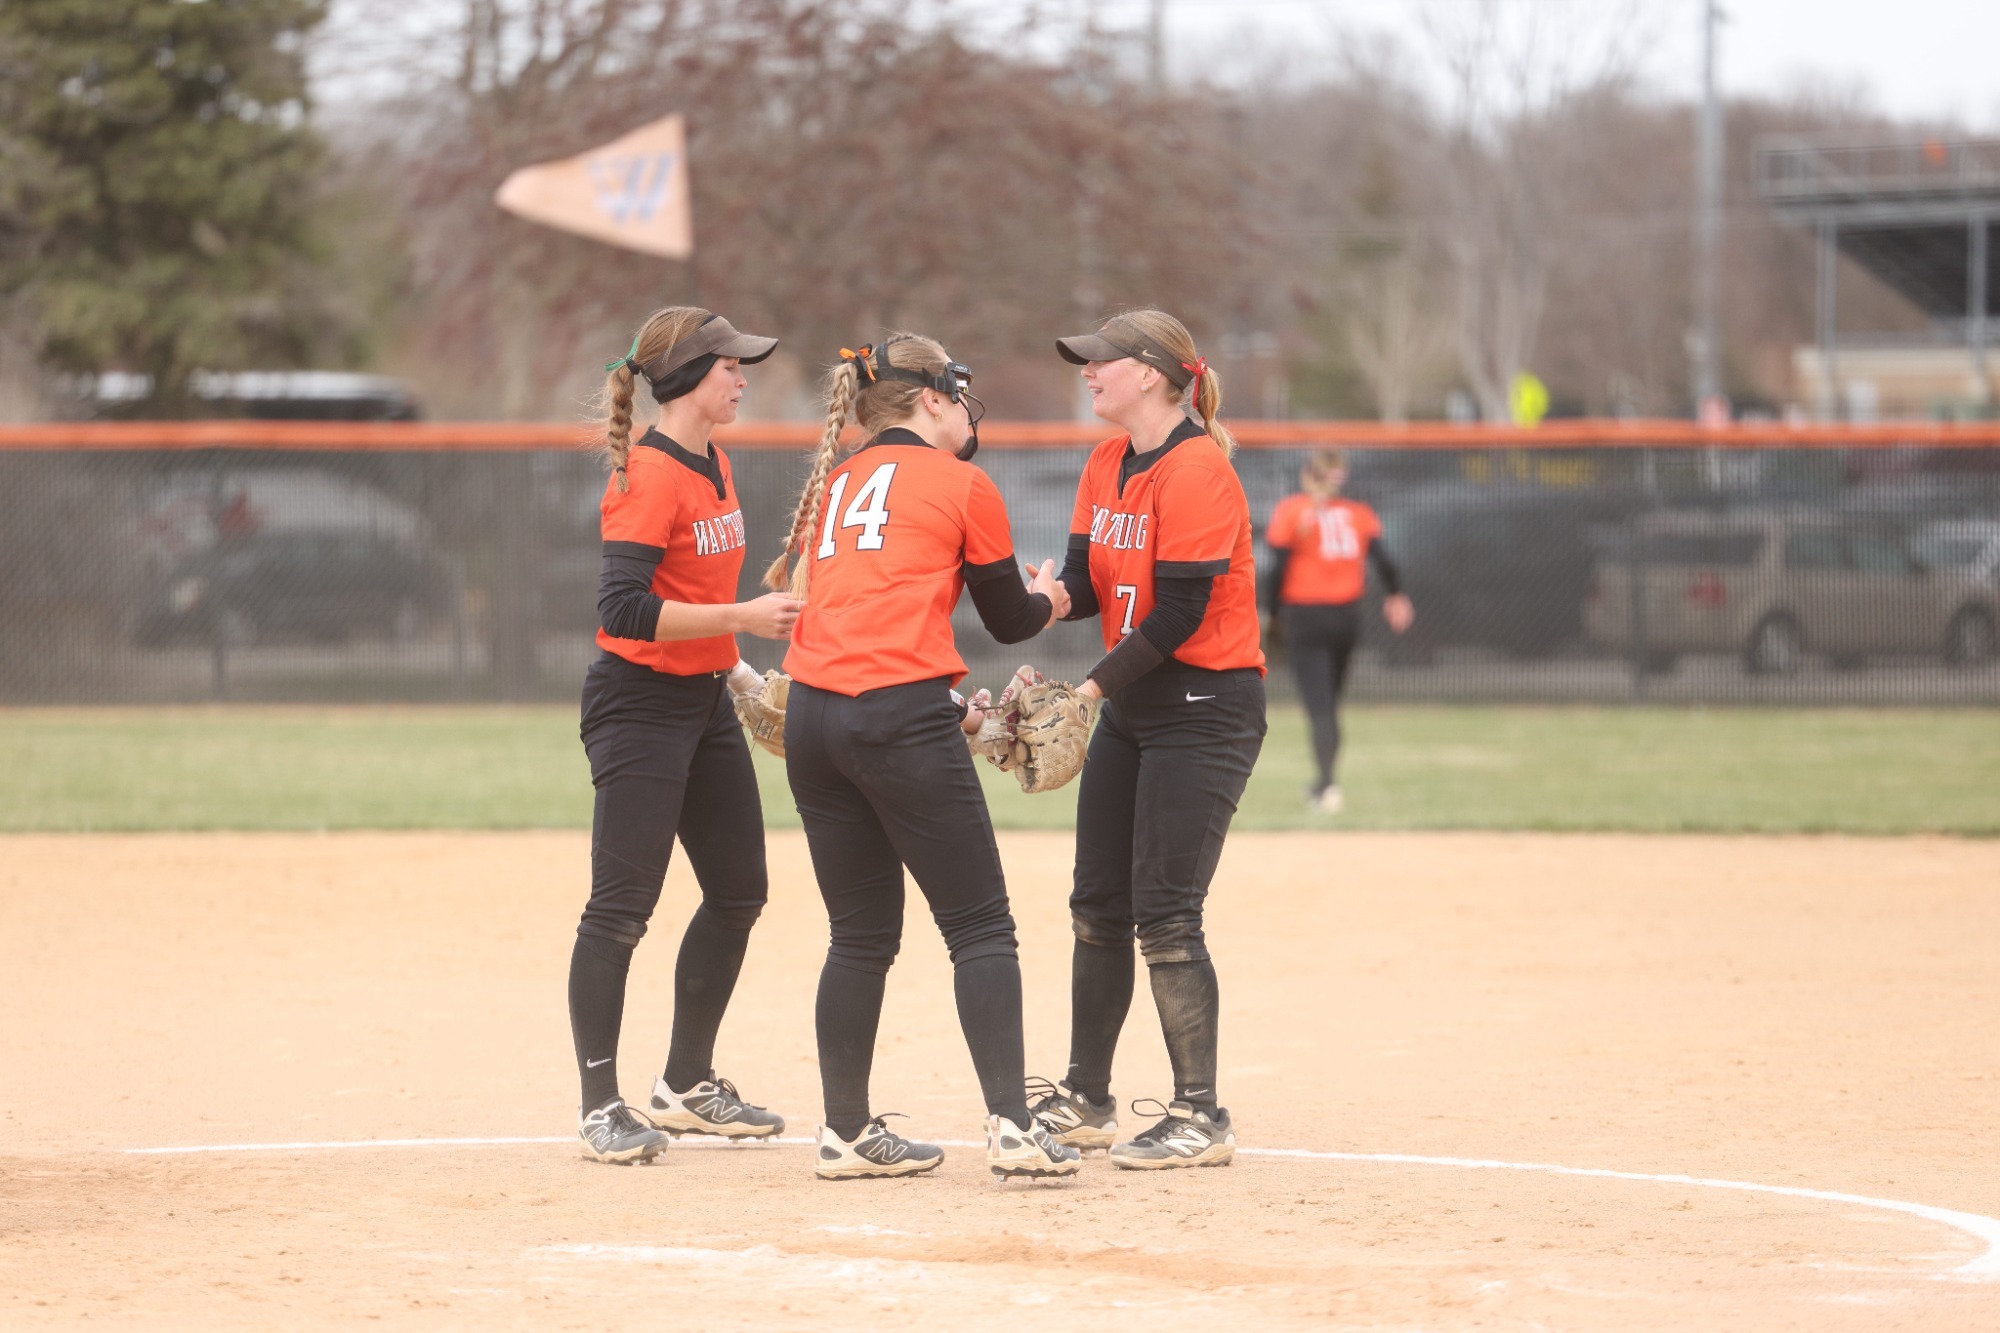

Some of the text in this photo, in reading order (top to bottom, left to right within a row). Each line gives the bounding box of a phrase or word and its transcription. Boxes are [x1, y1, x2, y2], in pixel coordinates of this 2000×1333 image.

[692, 509, 746, 557] WARTB
[817, 461, 899, 562] 14
[1115, 584, 1137, 636] 7
